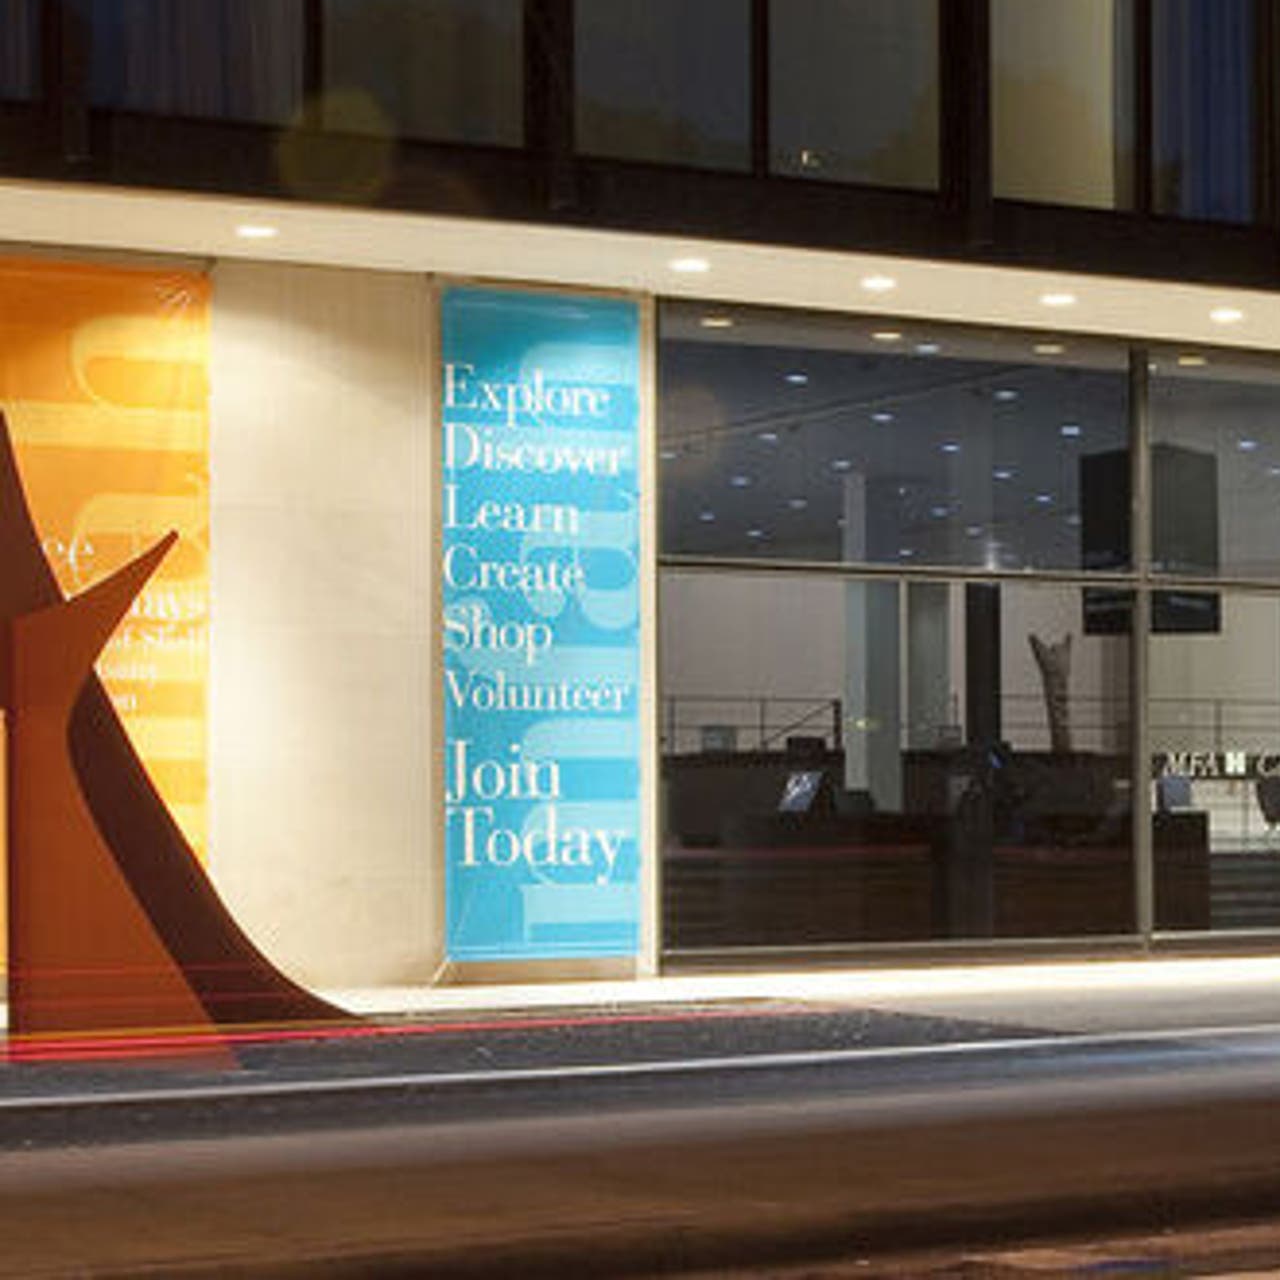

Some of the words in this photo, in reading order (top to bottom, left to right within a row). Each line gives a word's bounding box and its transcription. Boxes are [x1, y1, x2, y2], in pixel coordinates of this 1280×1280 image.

[443, 363, 612, 429] Explore
[443, 422, 627, 476] Discover
[444, 483, 580, 536] Learn
[443, 542, 586, 591] Create
[442, 602, 553, 666] Shop
[445, 669, 630, 712] Volunteer
[444, 738, 564, 804] Join
[444, 803, 628, 886] Today
